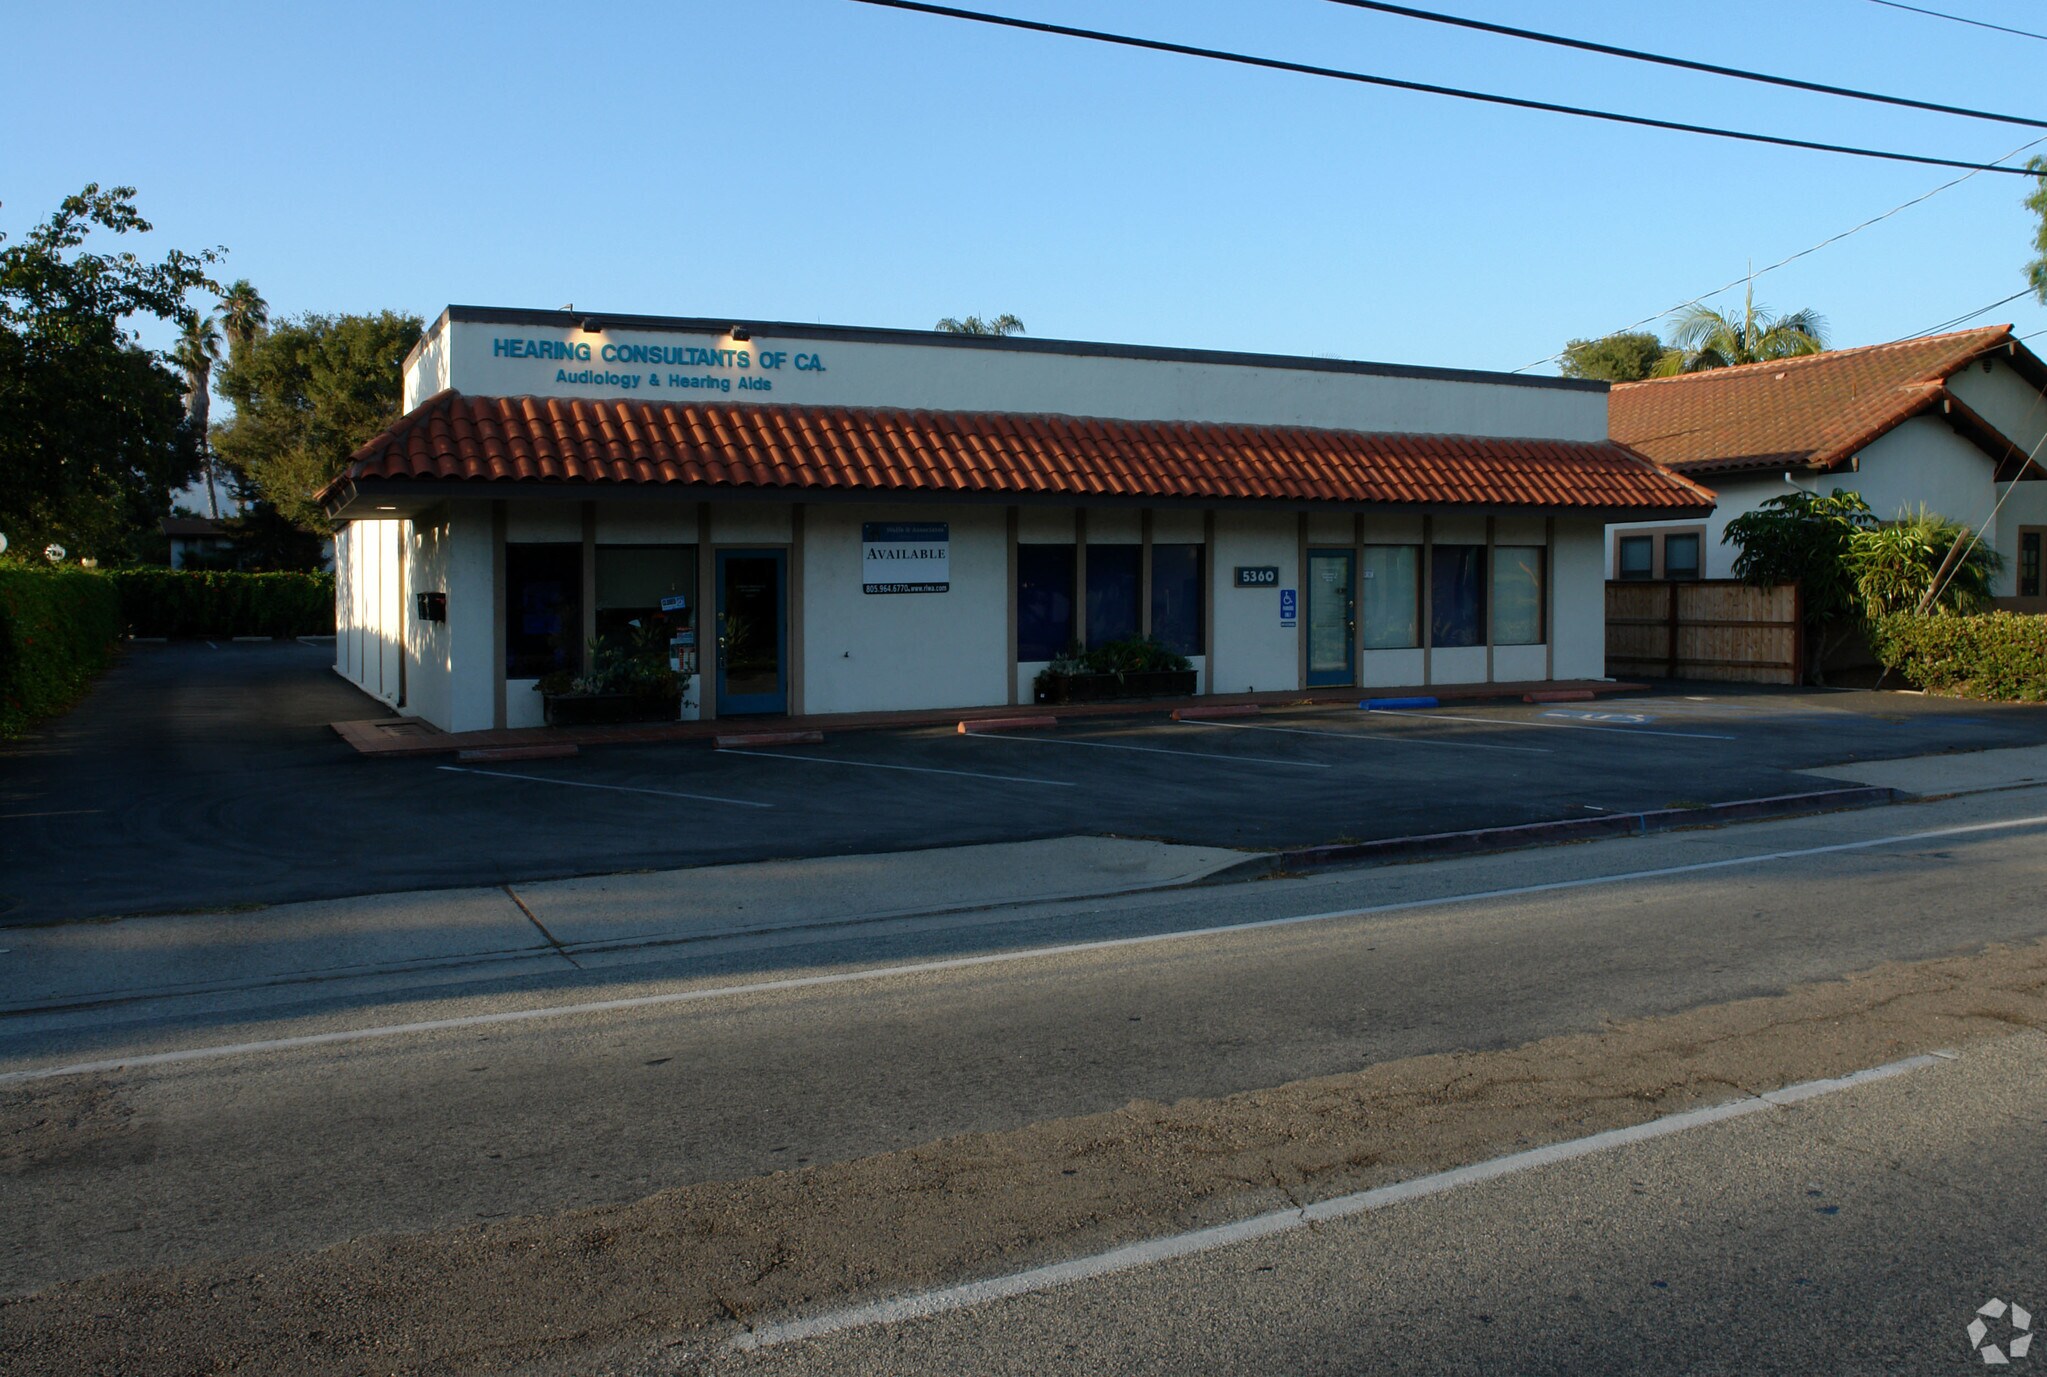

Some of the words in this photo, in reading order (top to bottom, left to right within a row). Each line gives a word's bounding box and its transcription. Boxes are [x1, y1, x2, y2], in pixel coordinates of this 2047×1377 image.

[494, 338, 591, 361] HEARING
[601, 343, 750, 368] CONSULTANTS
[759, 351, 787, 369] OF
[794, 353, 827, 372] CA.
[556, 369, 641, 389] Audiology
[649, 373, 660, 386] &
[669, 374, 731, 392] Hearing
[738, 376, 773, 391] Aids
[1243, 571, 1275, 582] 5360
